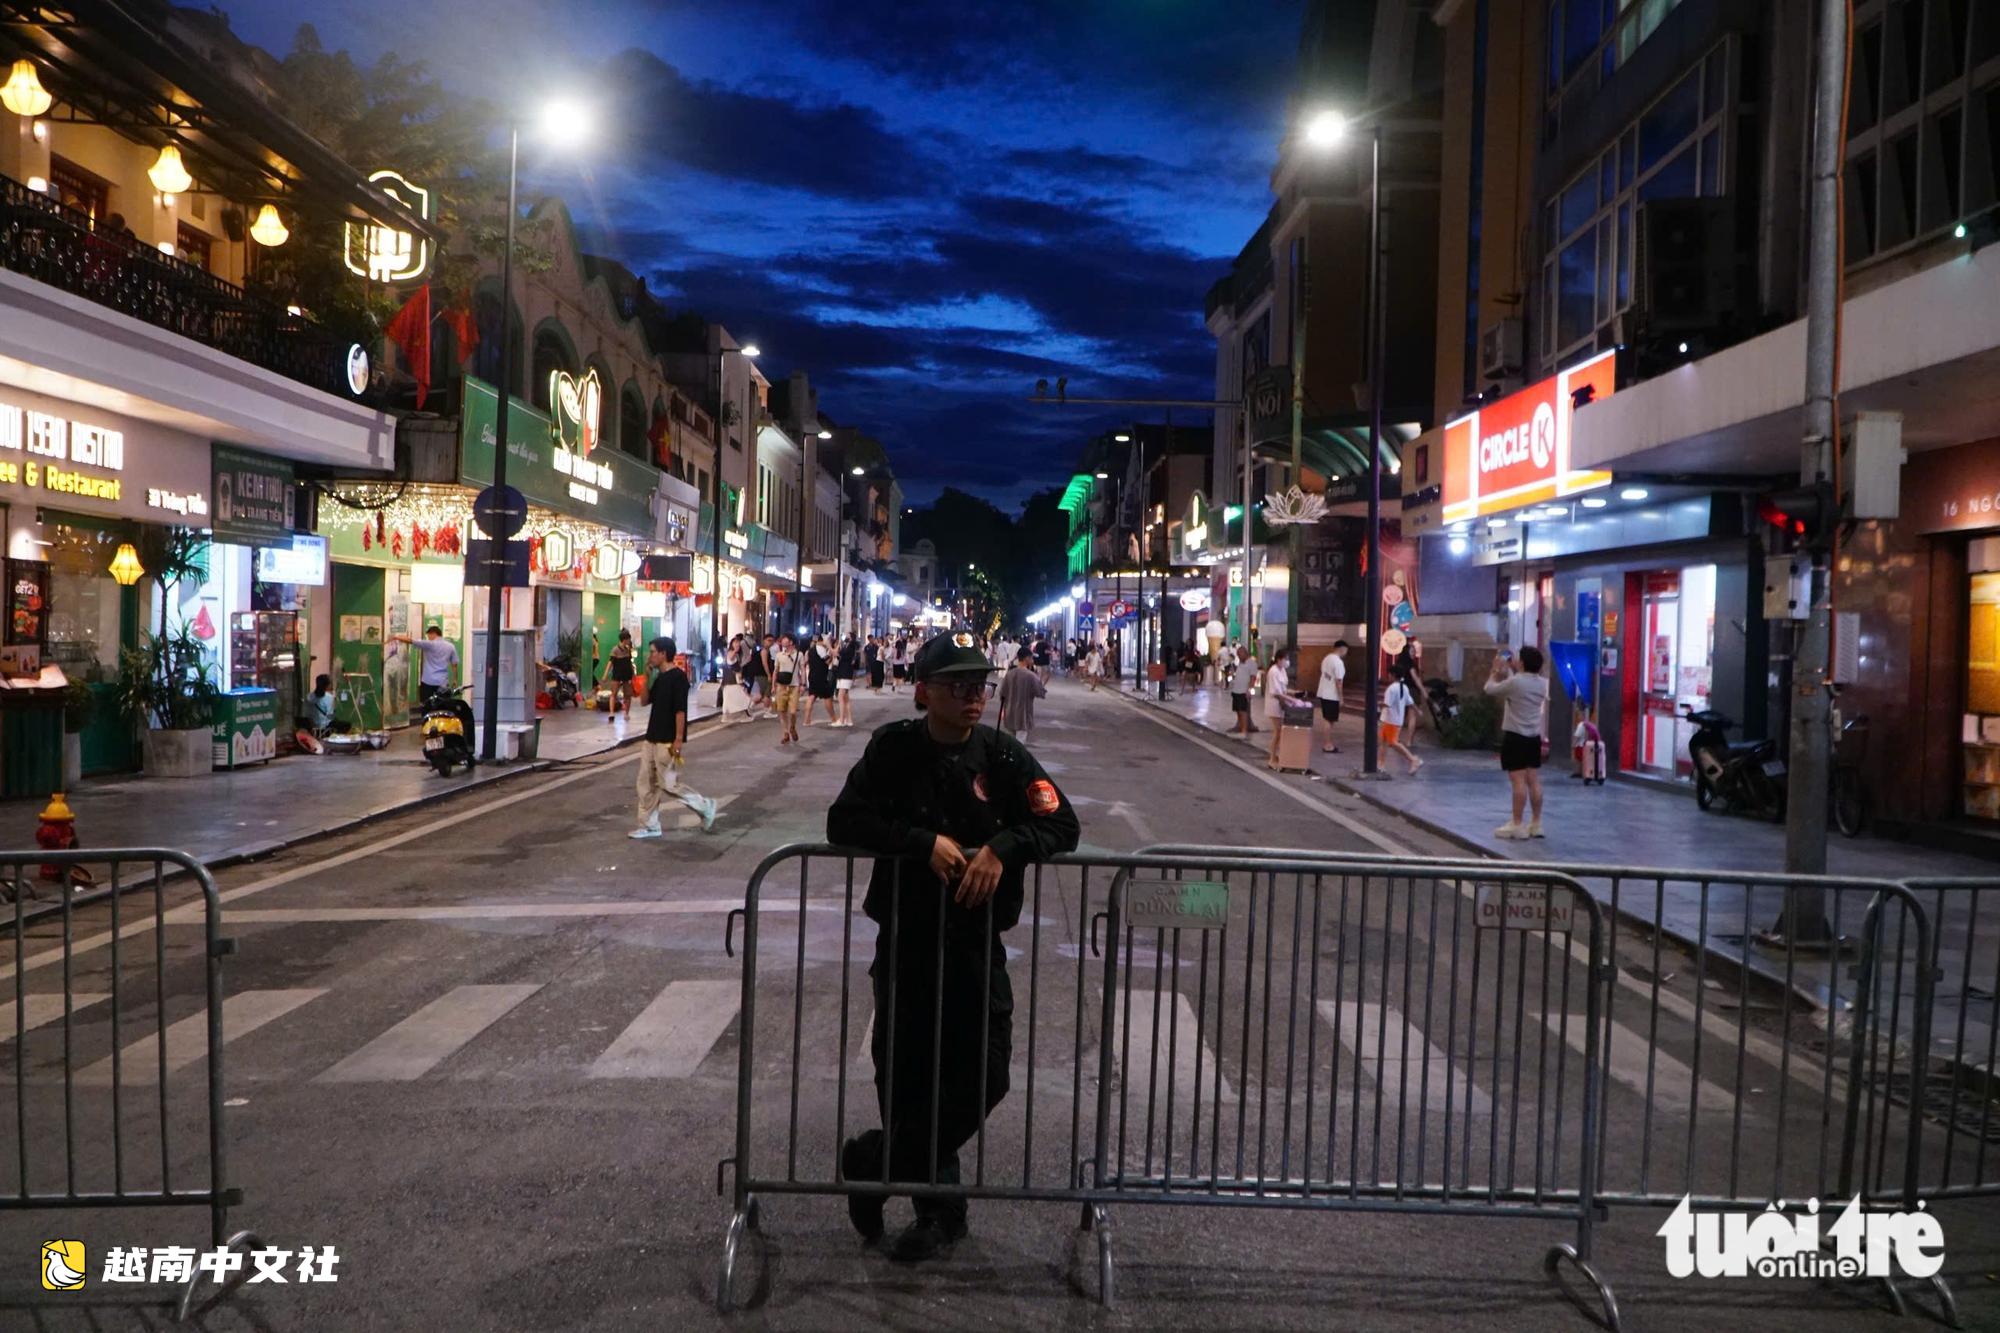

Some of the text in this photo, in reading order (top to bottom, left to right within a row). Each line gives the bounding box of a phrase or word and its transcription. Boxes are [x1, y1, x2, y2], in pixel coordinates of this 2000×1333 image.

[27, 410, 67, 459] 1530
[1480, 409, 1555, 473] CIRCLE K
[25, 461, 38, 487] &
[47, 465, 121, 501] Restaurant
[238, 471, 264, 500] KEM
[1943, 501, 1958, 517] 16
